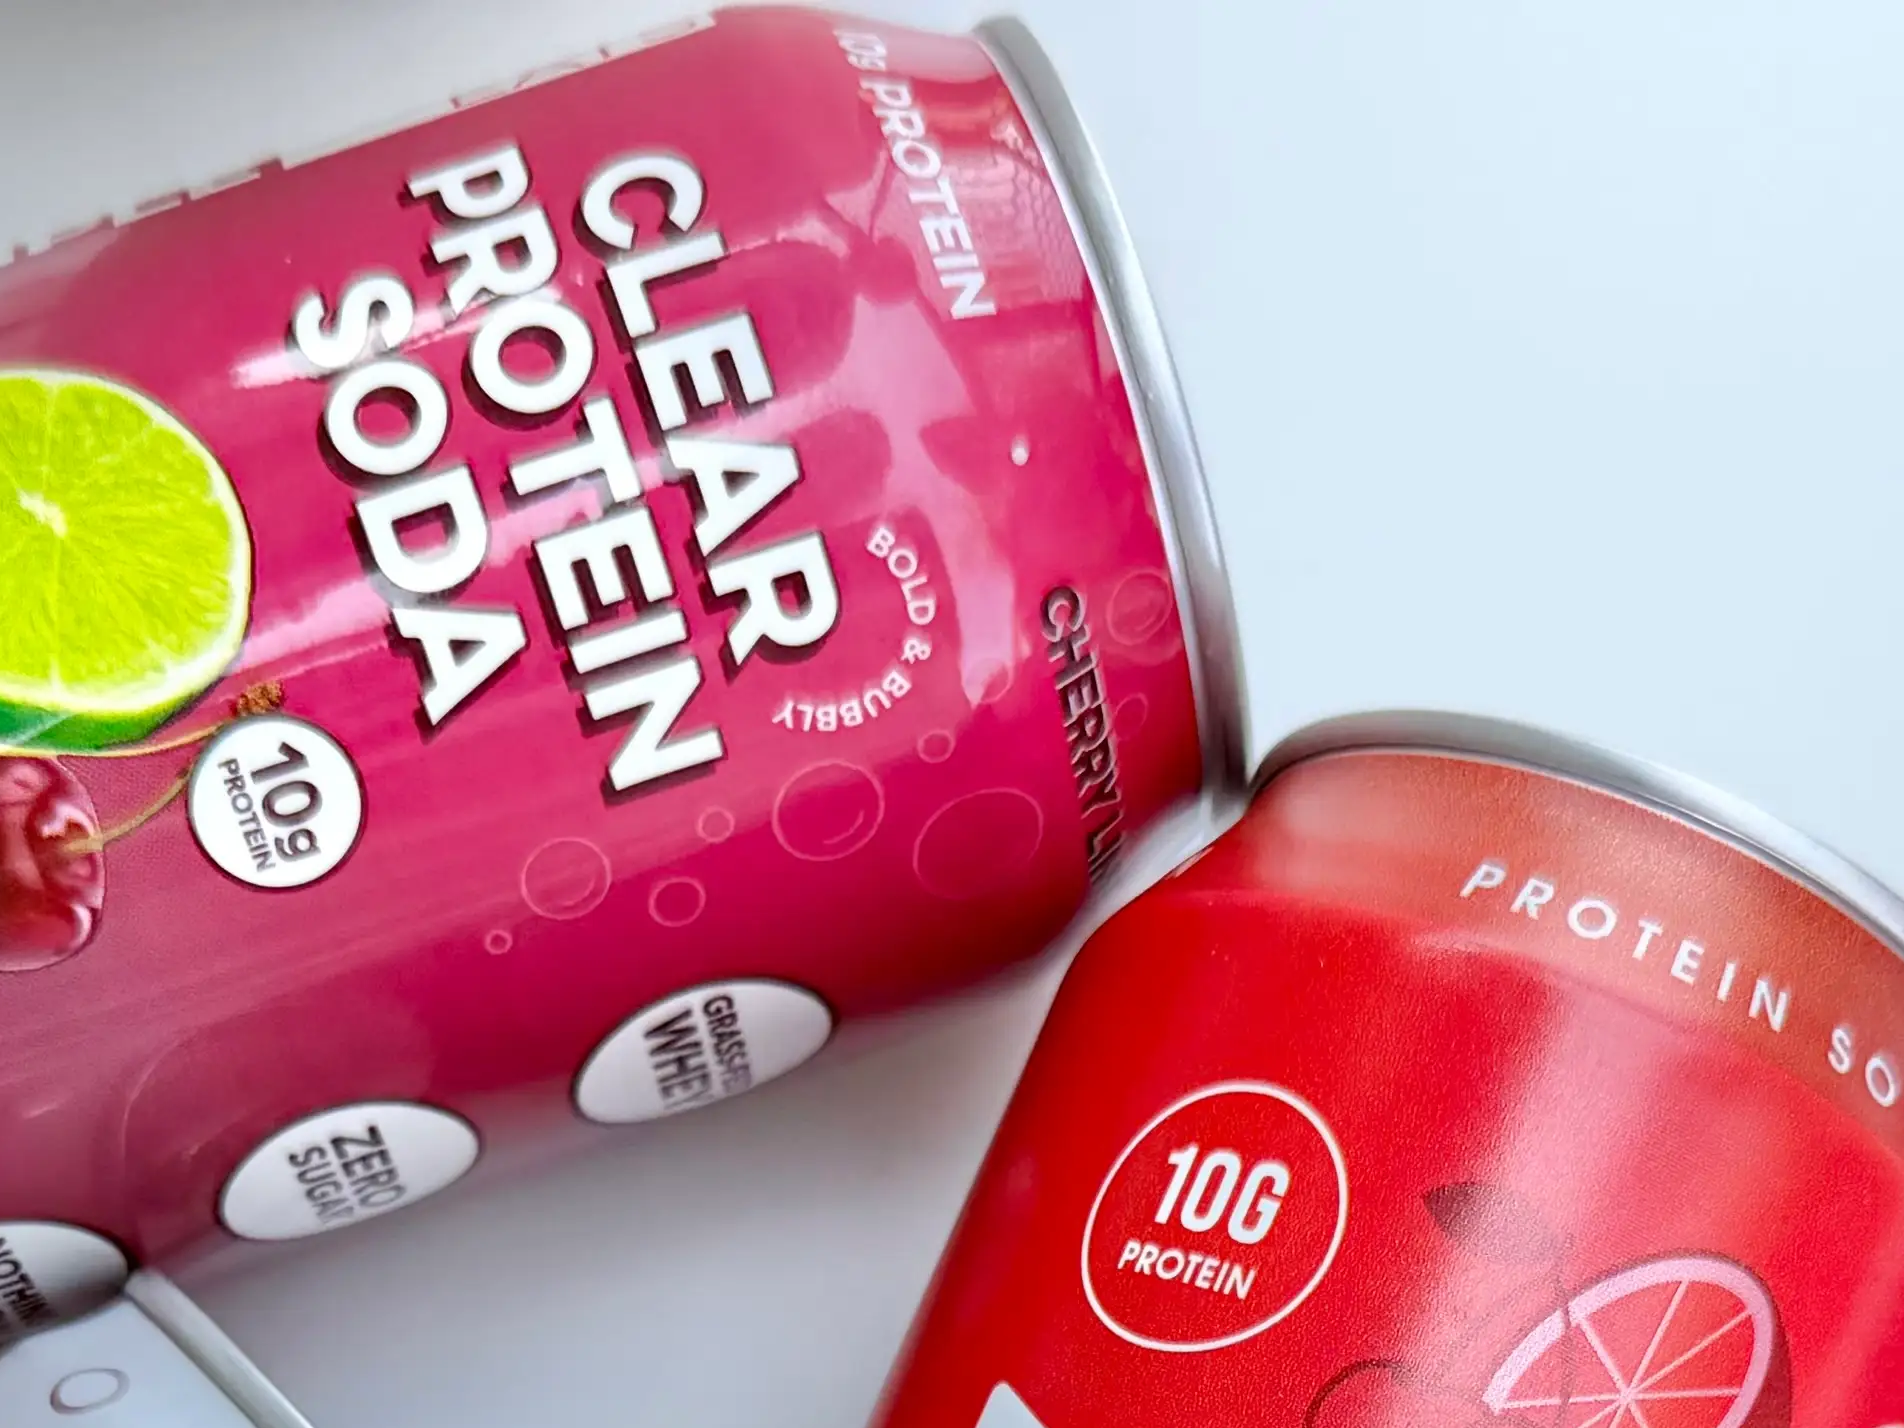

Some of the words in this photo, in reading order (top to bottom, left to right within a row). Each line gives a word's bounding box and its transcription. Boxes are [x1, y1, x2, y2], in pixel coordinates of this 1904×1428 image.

[860, 76, 997, 320] PROTEIN
[408, 143, 725, 791] PROTEIN
[582, 152, 840, 664] CLEAR
[294, 273, 526, 728] SODA
[867, 526, 937, 627] BOLD
[772, 671, 910, 734] BUBBLY
[901, 638, 933, 665] &
[1041, 584, 1122, 822] CHERRY
[218, 757, 277, 873] PROTEIN
[251, 742, 323, 863] 10g
[1461, 858, 1793, 1034] PROTEIN
[330, 1125, 407, 1208] ZERO
[1154, 1143, 1291, 1246] 10G
[1117, 1239, 1256, 1302] PROTEIN
